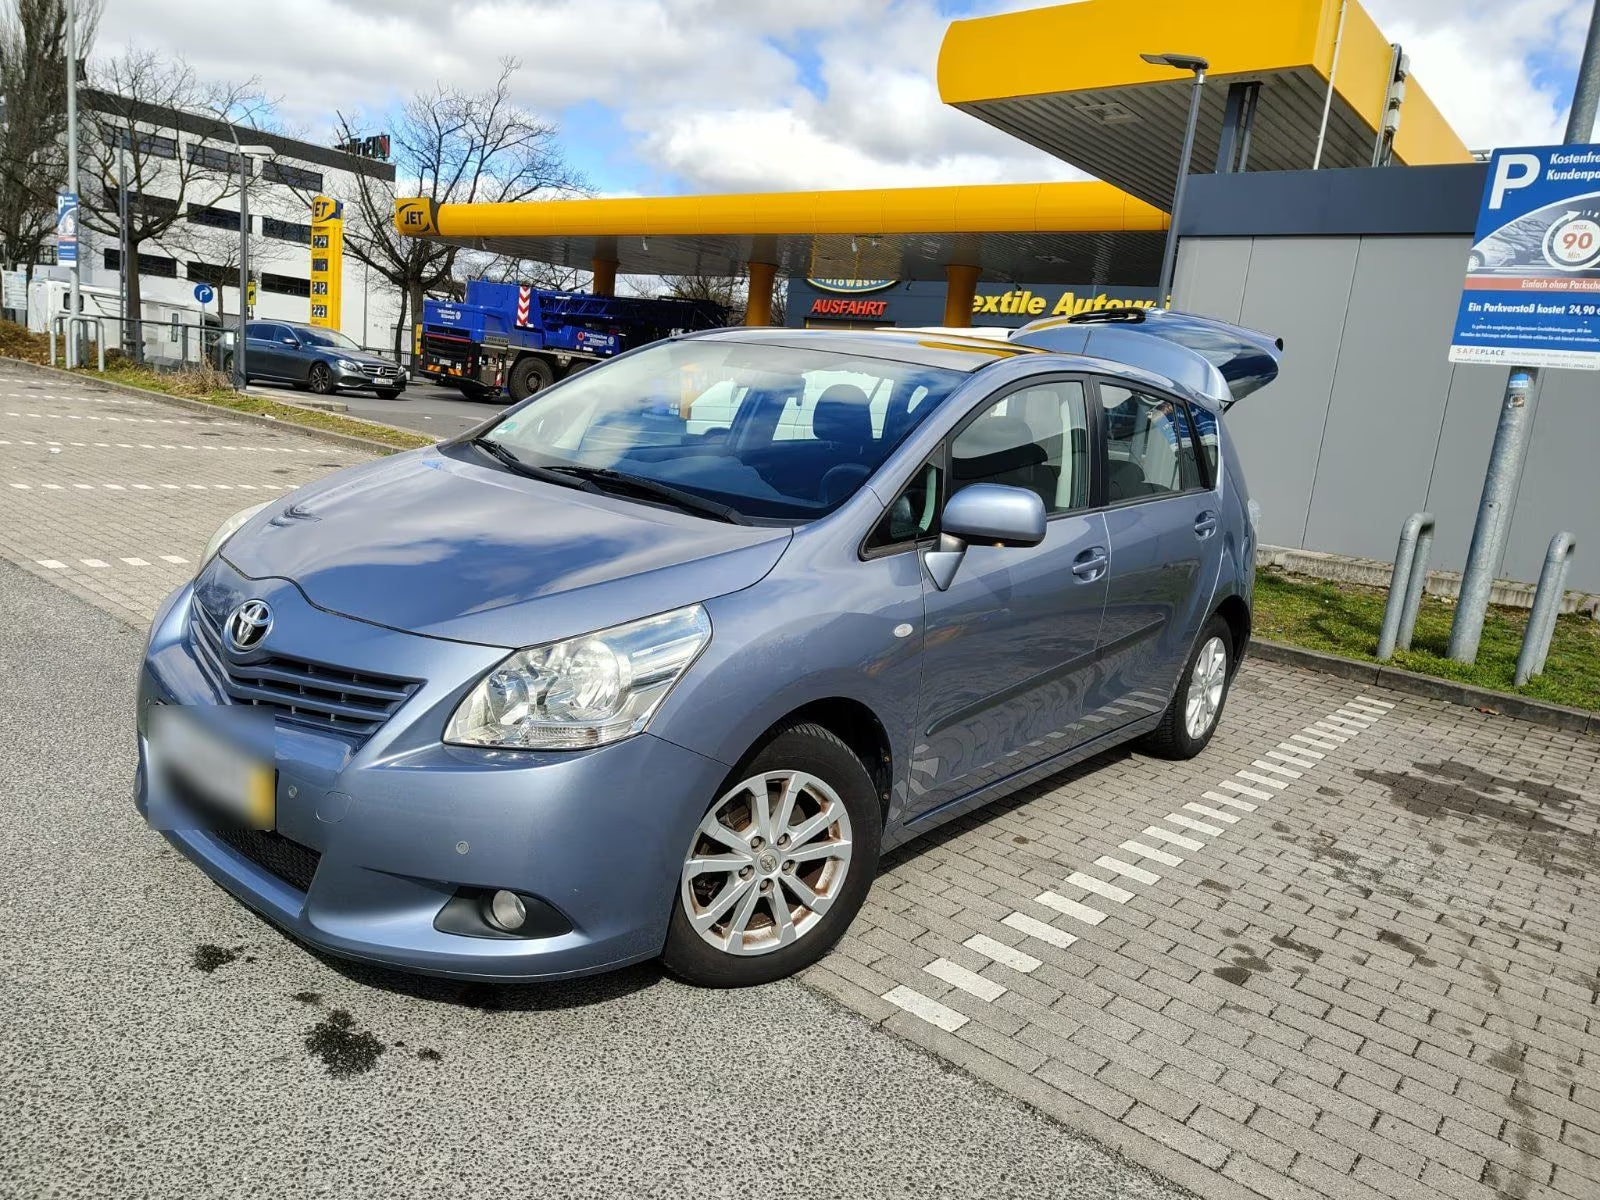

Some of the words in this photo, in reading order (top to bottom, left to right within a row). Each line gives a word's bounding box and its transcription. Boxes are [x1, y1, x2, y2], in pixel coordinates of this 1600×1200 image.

[1550, 151, 1600, 164] Kostenfre
[1488, 154, 1540, 209] P
[1547, 168, 1600, 182] Kundenpa
[404, 211, 424, 225] JET
[1563, 232, 1593, 249] 90
[1522, 280, 1547, 289] Einfach
[1549, 280, 1568, 289] ohne
[811, 299, 887, 315] AUSFAHRT
[972, 291, 1047, 315] extile
[1052, 292, 1170, 315] Autow
[1468, 302, 1482, 312] Ein
[1483, 303, 1535, 313] Parkverstoß
[1537, 304, 1566, 314] kostet
[1569, 305, 1595, 315] 24,90
[1456, 348, 1505, 356] SAFEPLACE
